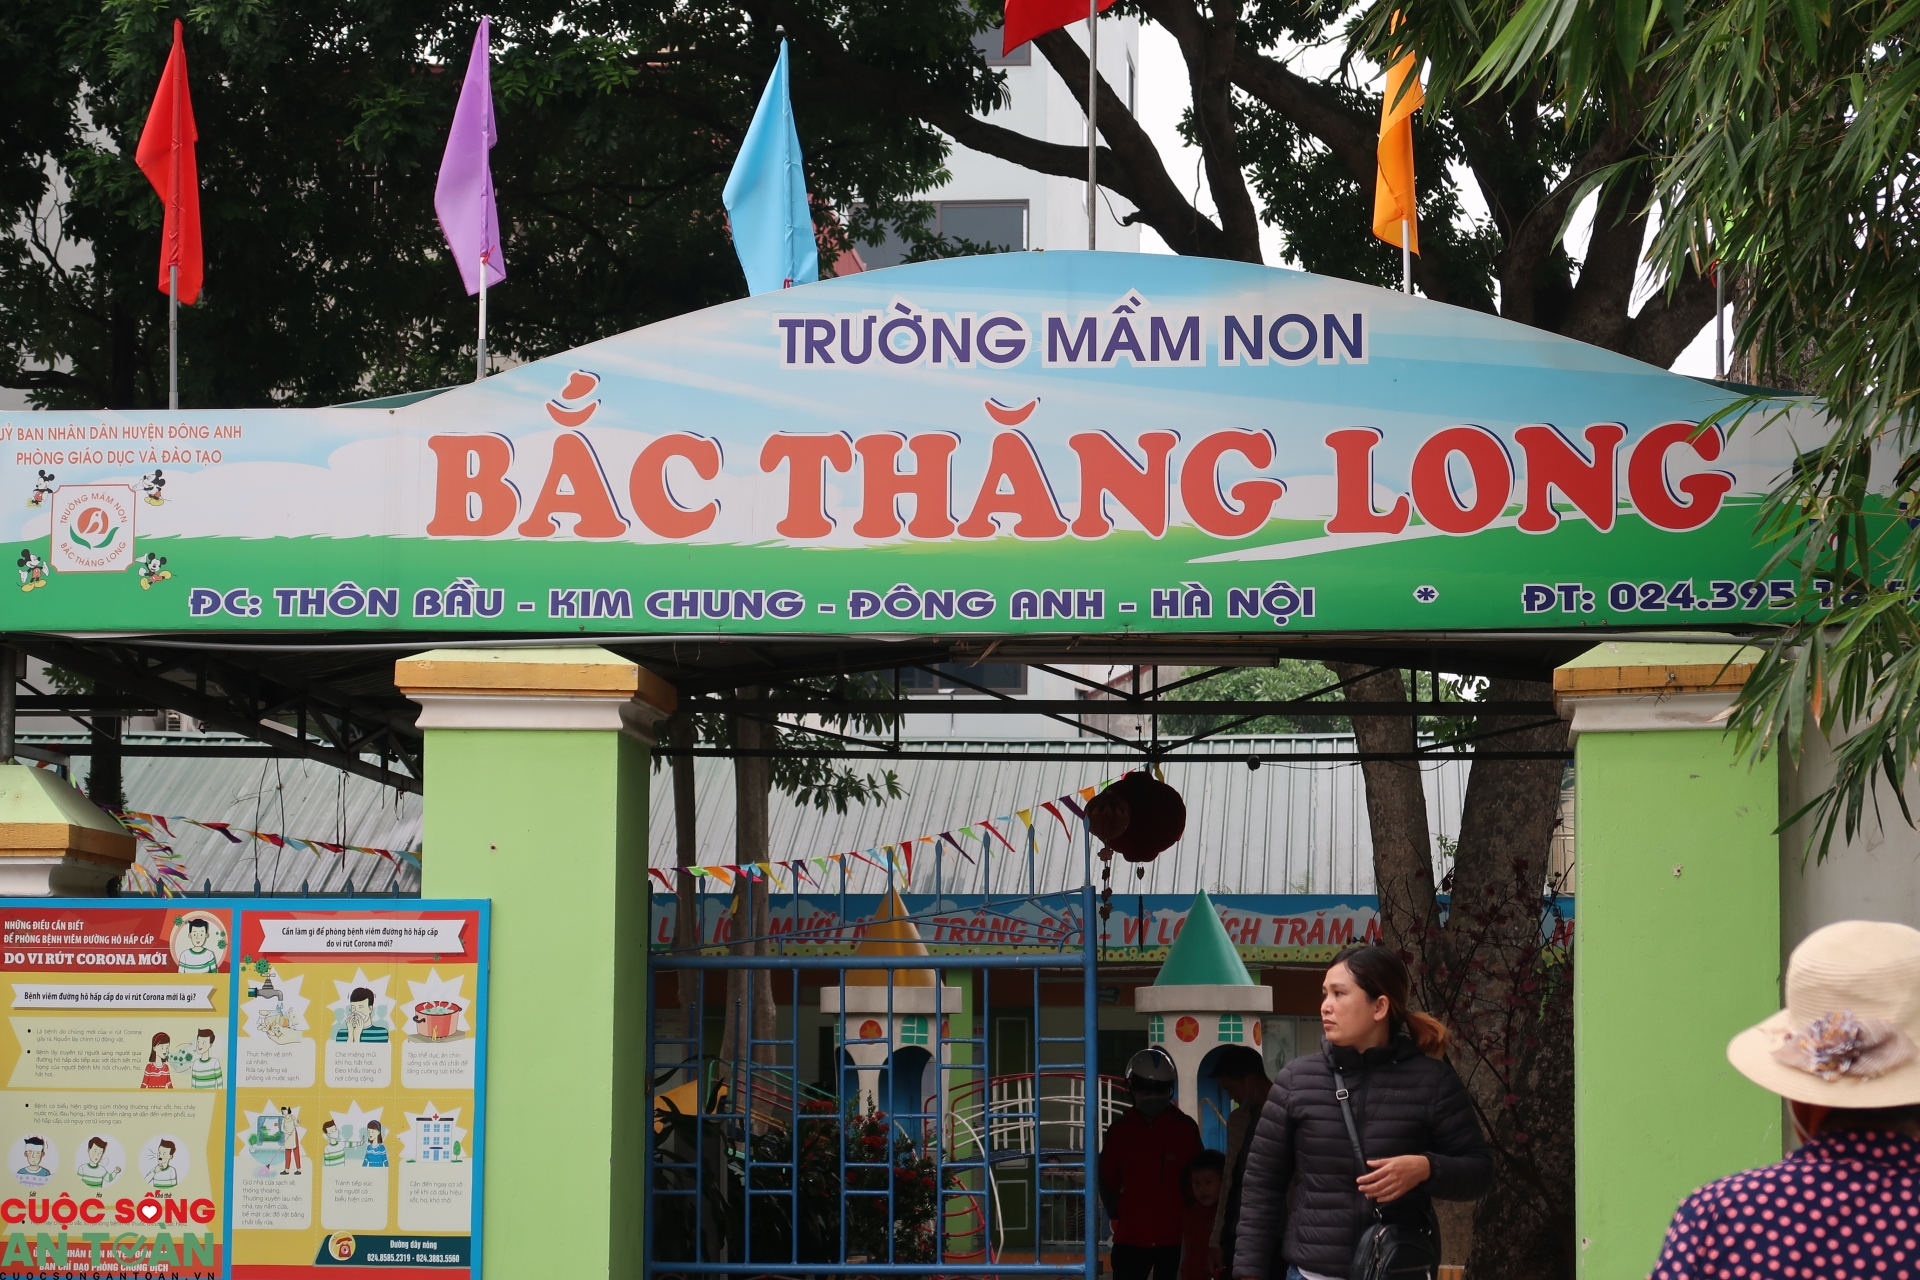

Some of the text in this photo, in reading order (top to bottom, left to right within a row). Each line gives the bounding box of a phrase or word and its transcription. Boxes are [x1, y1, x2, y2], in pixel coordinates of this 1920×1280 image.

[779, 296, 1362, 364] TRƯỜNG MẦM NON
[17, 427, 44, 440] BAN
[48, 423, 85, 440] NHÂN
[90, 423, 118, 440] DÂN
[122, 422, 164, 442] HUYỆN
[168, 423, 209, 439] ĐÔNG
[213, 425, 242, 439] ANH
[16, 446, 222, 467] PHÒNG GIÁO DỤC VÀ ĐÀO TẠO
[426, 370, 1735, 539] BẮC THĂNG LONG
[113, 502, 128, 523] NON
[105, 541, 126, 563] LONG
[190, 588, 262, 617] ĐC:
[274, 581, 399, 618] THÔN
[413, 577, 504, 618] BẦU
[517, 602, 535, 612] -
[549, 588, 633, 619] KIM
[645, 589, 805, 620] CHUNG
[818, 604, 835, 614] -
[848, 582, 996, 620] ĐÔNG
[1010, 589, 1105, 620] ANH
[1119, 602, 1137, 612] -
[1150, 581, 1212, 619] HÀ
[1227, 581, 1315, 626] NỘI
[1521, 583, 1596, 614] ĐT:
[1608, 577, 1797, 612] 024.395
[3, 930, 154, 945] ĐỂ PHÒNG BỆNH VIÊM ĐƯỜNG HÔ HẤP CẤP
[1123, 910, 1151, 946] VÌ
[1271, 911, 1353, 946] TRĂM
[326, 939, 334, 947] do
[335, 939, 341, 947] vi
[353, 939, 376, 947] Corona
[377, 939, 393, 947] mới?
[4, 950, 168, 965] DO VI RÚT CORONA MỚI
